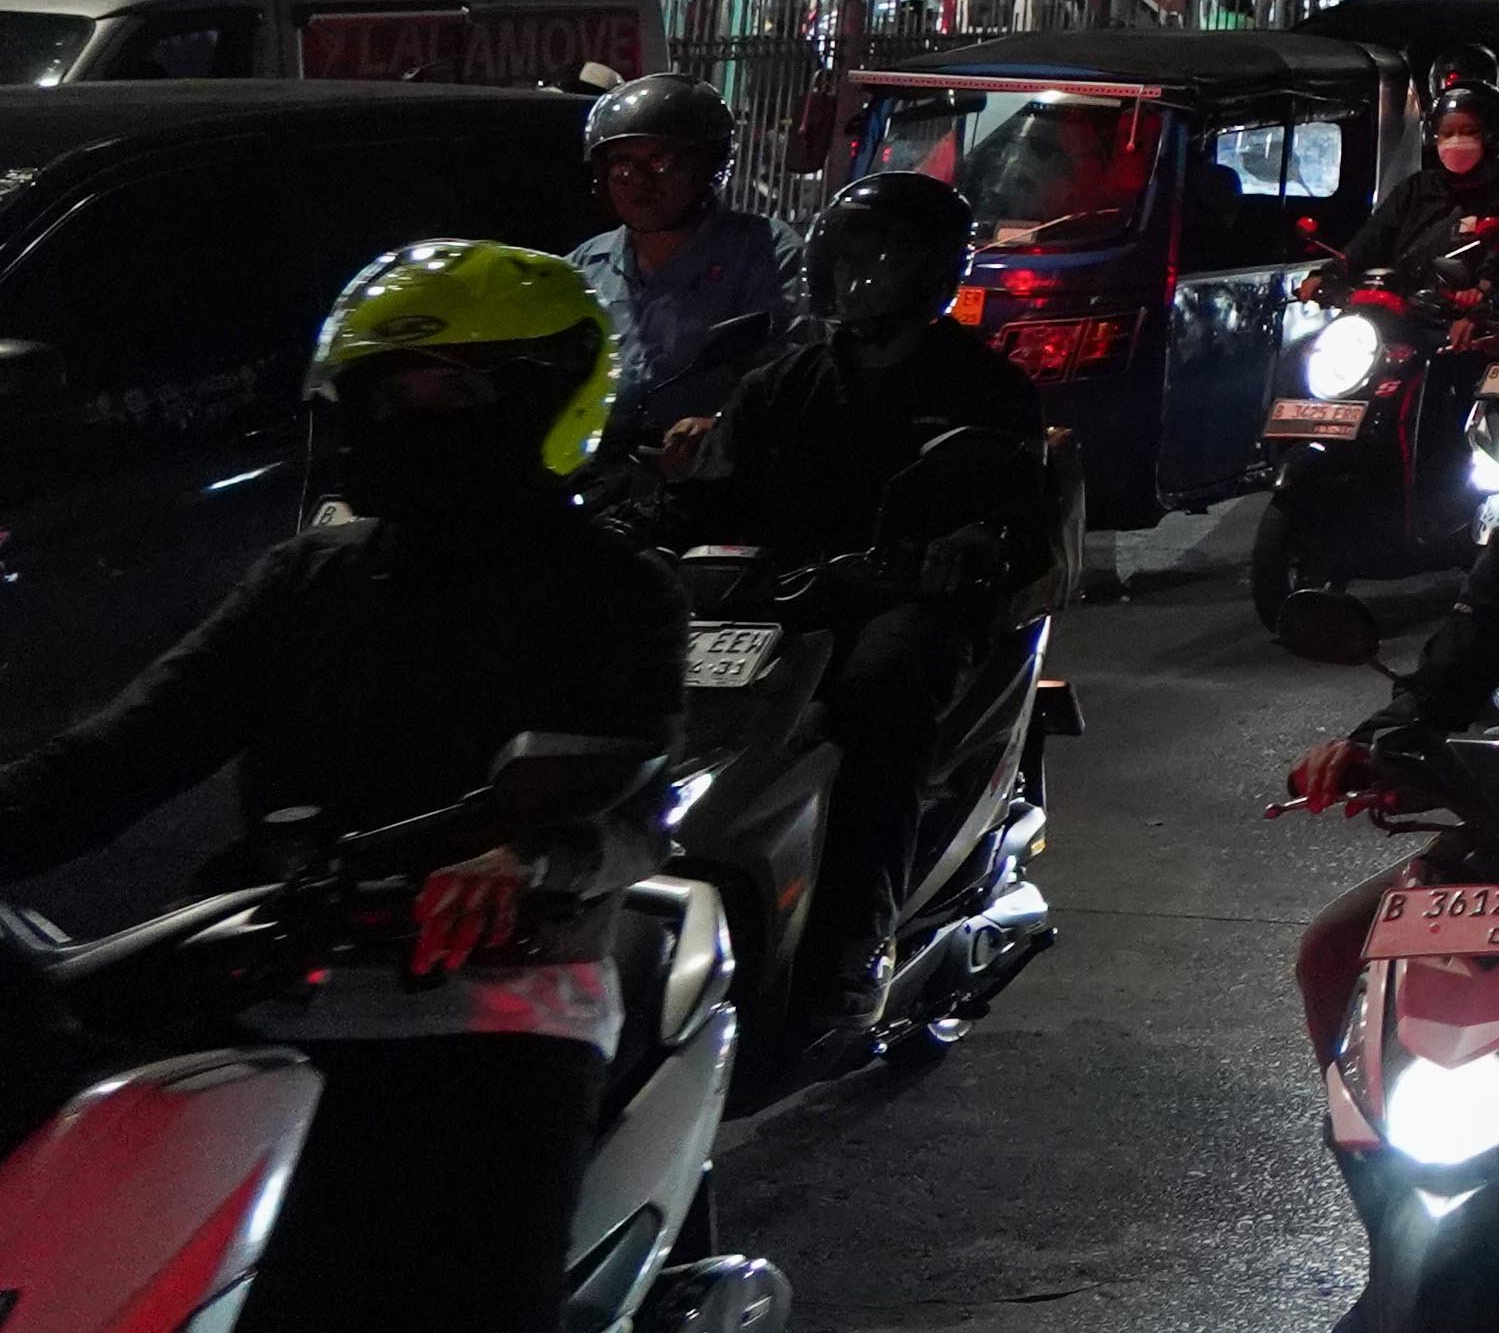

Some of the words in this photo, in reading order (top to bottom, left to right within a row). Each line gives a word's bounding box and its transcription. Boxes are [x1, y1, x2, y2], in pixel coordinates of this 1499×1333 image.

[354, 14, 638, 81] LALAMOVE
[1488, 367, 1499, 379] B
[320, 506, 336, 525] B
[1383, 892, 1407, 923] B
